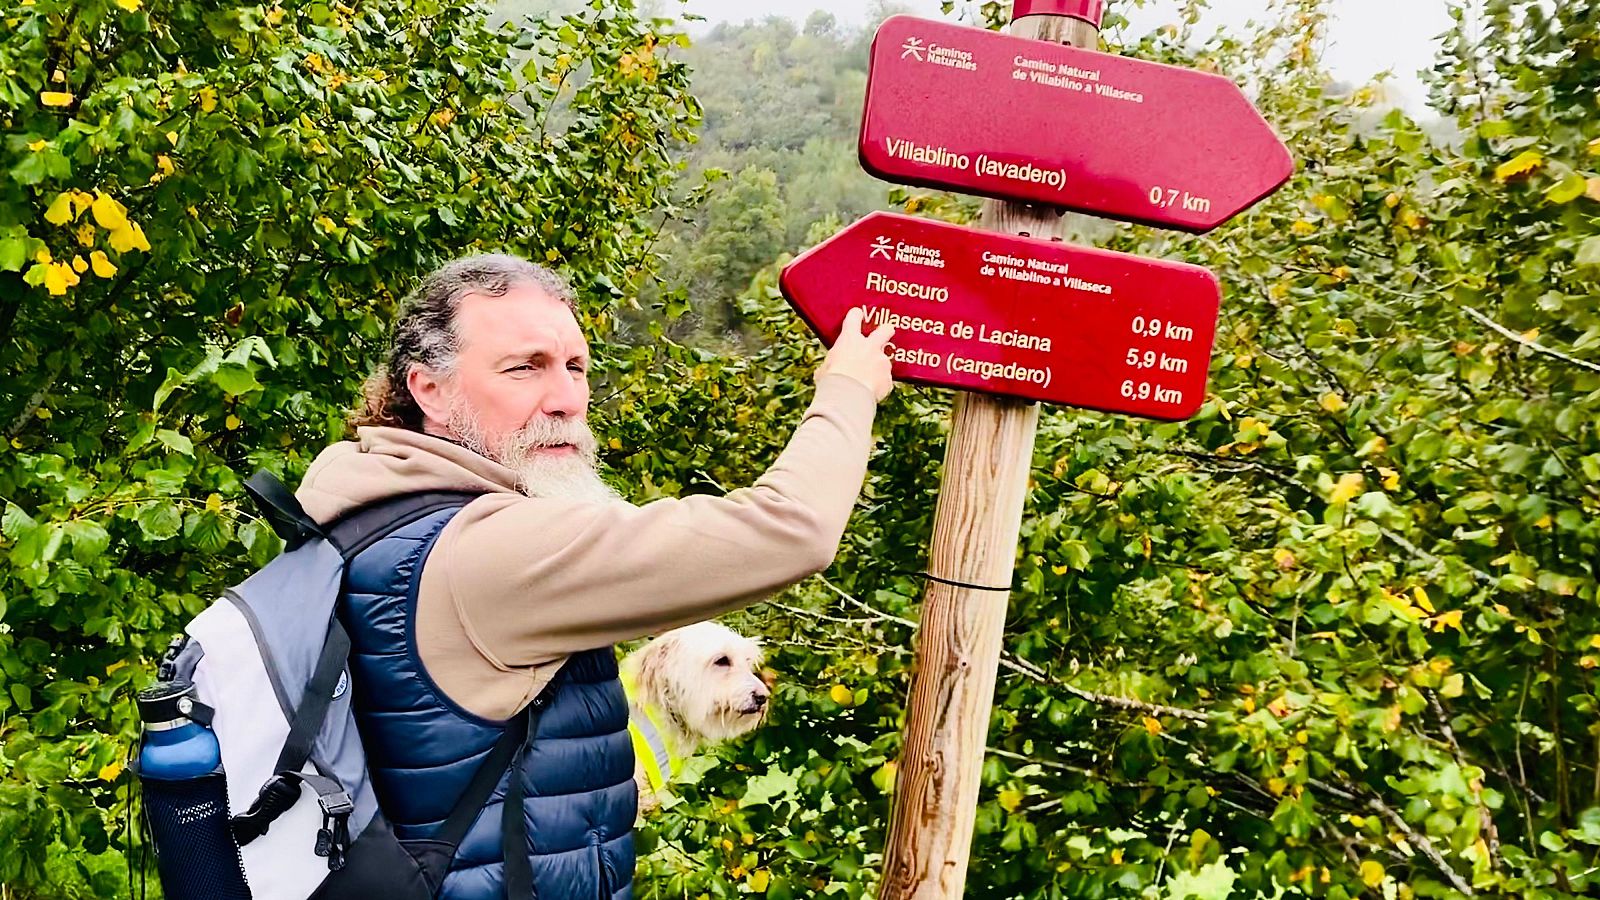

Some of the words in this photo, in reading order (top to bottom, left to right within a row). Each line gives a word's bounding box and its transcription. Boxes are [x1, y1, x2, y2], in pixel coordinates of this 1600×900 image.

[927, 52, 977, 71] Naturales
[928, 43, 973, 61] Caminos
[1013, 55, 1057, 73] Camino
[1058, 63, 1101, 81] Natural
[1012, 68, 1028, 81] de
[1029, 70, 1083, 91] Villablino
[1084, 83, 1092, 93] a
[1095, 83, 1144, 103] Villaseca
[885, 136, 970, 170] Villablino
[975, 154, 1067, 191] (lavadero)
[1149, 186, 1180, 208] 0,7
[1182, 191, 1211, 213] km
[895, 251, 945, 268] Naturales
[896, 241, 941, 258] Caminos
[981, 251, 1025, 267] Camino
[1027, 258, 1069, 274] Natural
[865, 271, 949, 303] Rioscuro
[980, 264, 996, 276] de
[998, 266, 1052, 285] Villablino
[1052, 277, 1061, 286] a
[1063, 276, 1112, 294] Villaseca
[862, 304, 945, 336] Villaseca
[949, 321, 974, 340] de
[979, 324, 1052, 352] Laciana
[1131, 316, 1162, 337] 0,9
[1164, 321, 1194, 342] km
[946, 353, 1052, 389] (cargadero)
[1125, 347, 1157, 369] 5,9
[1160, 352, 1188, 373] km
[1120, 380, 1151, 401] 6,9
[1154, 384, 1183, 405] km
